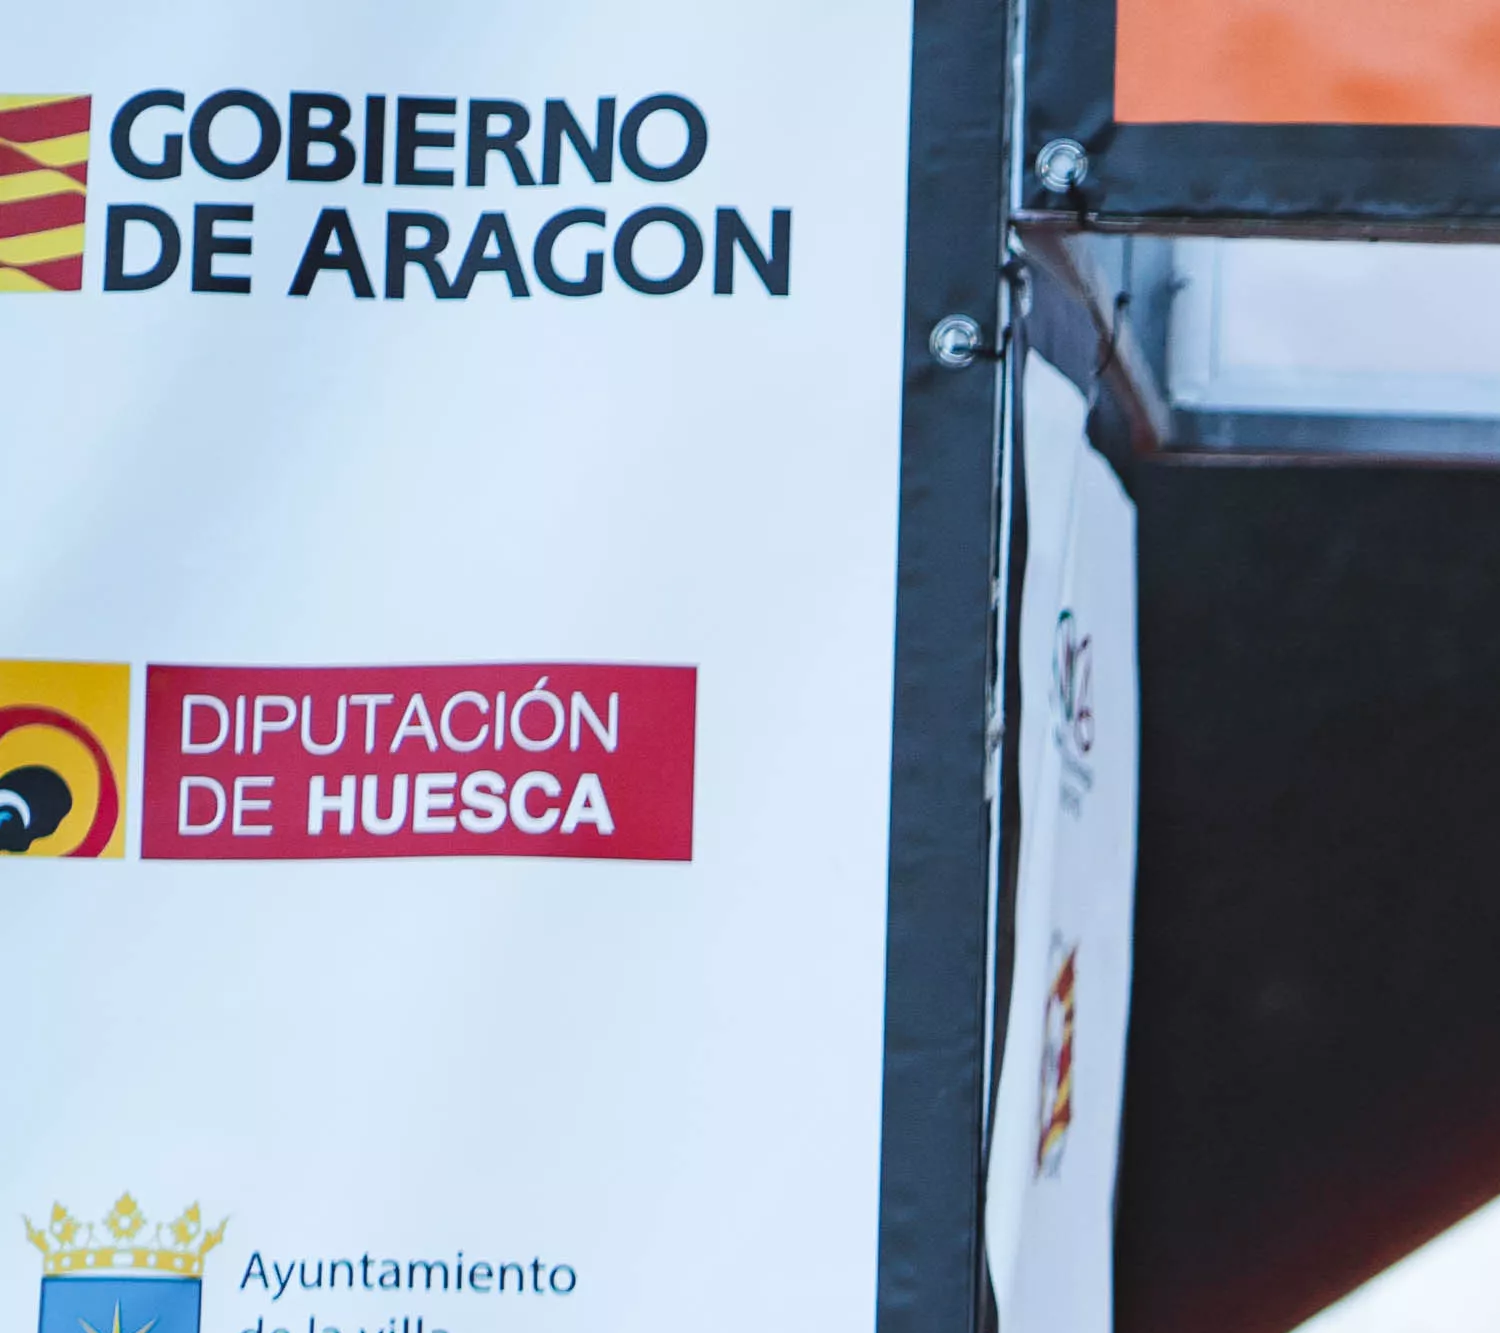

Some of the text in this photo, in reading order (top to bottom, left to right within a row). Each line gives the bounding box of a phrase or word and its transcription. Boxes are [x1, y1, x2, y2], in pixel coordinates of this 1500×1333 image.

[110, 89, 708, 186] GOBIERNO
[103, 203, 793, 301] DE ARAGON
[181, 677, 620, 757] DIPUTACIÓN
[178, 773, 614, 837] DE HUESCA
[239, 1247, 578, 1303] Ayuntamiento
